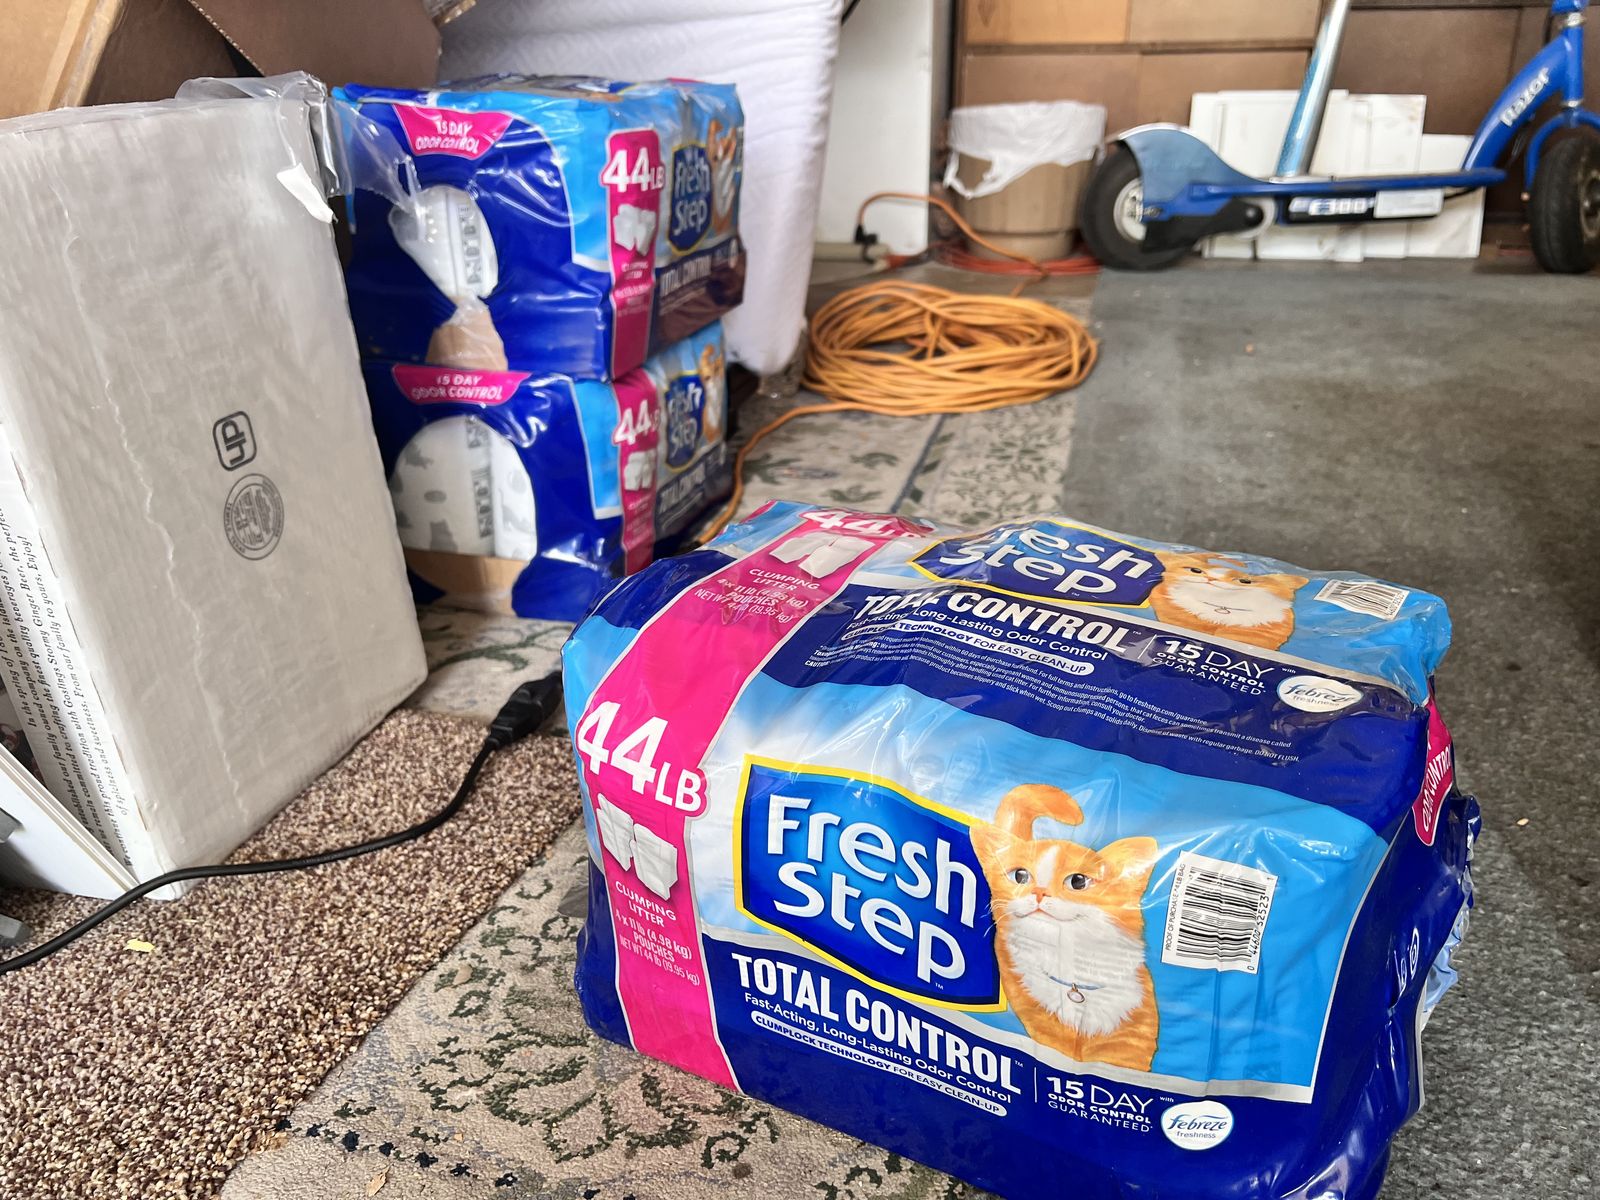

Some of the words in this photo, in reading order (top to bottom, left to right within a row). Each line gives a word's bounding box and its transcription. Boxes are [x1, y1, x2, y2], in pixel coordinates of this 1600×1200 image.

[449, 121, 473, 136] DAY
[448, 385, 503, 400] CONTROL
[452, 374, 482, 386] DAY
[8, 547, 20, 561] the
[16, 535, 37, 569] Enjoy!
[16, 567, 30, 590] Beer,
[749, 567, 821, 591] CLUMPING
[940, 544, 1117, 594] Step
[0, 576, 23, 621] beverages
[34, 574, 53, 605] yours,
[726, 587, 778, 611] POUCHES
[753, 577, 798, 593] LITTER
[26, 594, 43, 625] Ginger
[46, 608, 55, 618] to
[694, 588, 714, 600] NET
[748, 602, 776, 616] (19.95
[776, 612, 793, 623] kg)
[6, 629, 17, 642] the
[49, 622, 70, 652] family
[912, 608, 1003, 637] Long-Lasting
[1006, 630, 1046, 646] Odor
[1048, 641, 1109, 662] Control
[947, 592, 1129, 652] CONTROL
[13, 646, 23, 657] on
[19, 625, 39, 657] quality
[40, 630, 57, 663] Stormy
[898, 621, 974, 645] TECHNOLOGY
[973, 638, 998, 651] FOR
[997, 644, 1029, 659] EASY
[1028, 652, 1088, 675] CLEAN-UP
[1, 657, 14, 666] of
[31, 660, 50, 686] finest
[62, 653, 74, 670] our
[1156, 651, 1195, 667] ODOR
[1199, 662, 1265, 690] CONTROL
[1164, 639, 1204, 660] 15
[1205, 650, 1275, 680] DAY
[1281, 666, 1297, 675] with
[9, 670, 27, 698] spring
[19, 660, 39, 699] company
[53, 668, 73, 706] Goslings
[70, 674, 84, 697] From
[1152, 656, 1262, 696] GUARANTEED
[20, 702, 32, 714] the
[42, 688, 53, 702] the
[49, 704, 67, 738] crafting
[66, 711, 81, 729] with
[46, 732, 65, 761] family
[64, 742, 73, 751] to
[78, 733, 96, 771] tradition
[767, 794, 977, 929] Fresh
[615, 881, 677, 922] CLUMPING
[628, 900, 664, 928] LITTER
[773, 861, 966, 984] Step
[633, 931, 673, 961] POUCHES
[647, 928, 671, 949] (4.98
[673, 940, 691, 959] kg)
[619, 934, 631, 950] NET
[631, 942, 642, 956] WT
[662, 958, 684, 977] (19.95
[686, 969, 700, 987] kg)
[732, 952, 839, 1022] TOTAL
[845, 988, 1021, 1095] CONTROL
[744, 992, 820, 1032] Fast-Acting,
[823, 1022, 912, 1067] Long-Lasting
[914, 1058, 954, 1081] Odor
[956, 1075, 1012, 1103] Control
[756, 1016, 817, 1046] CLUMPLOCK
[817, 1041, 892, 1071] TECHNOLOGY
[893, 1066, 915, 1081] FOR
[915, 1074, 944, 1091] EASY
[944, 1086, 1001, 1115] CLEAN-UP
[1046, 1077, 1085, 1099] 15
[1091, 1084, 1154, 1114] DAY
[1048, 1093, 1085, 1110] ODOR
[1090, 1105, 1151, 1125] CONTROL
[1159, 1095, 1175, 1103] with
[1048, 1100, 1151, 1133] GUARANTEED
[1166, 1113, 1229, 1131] febreze
[1176, 1130, 1217, 1139] freshness
